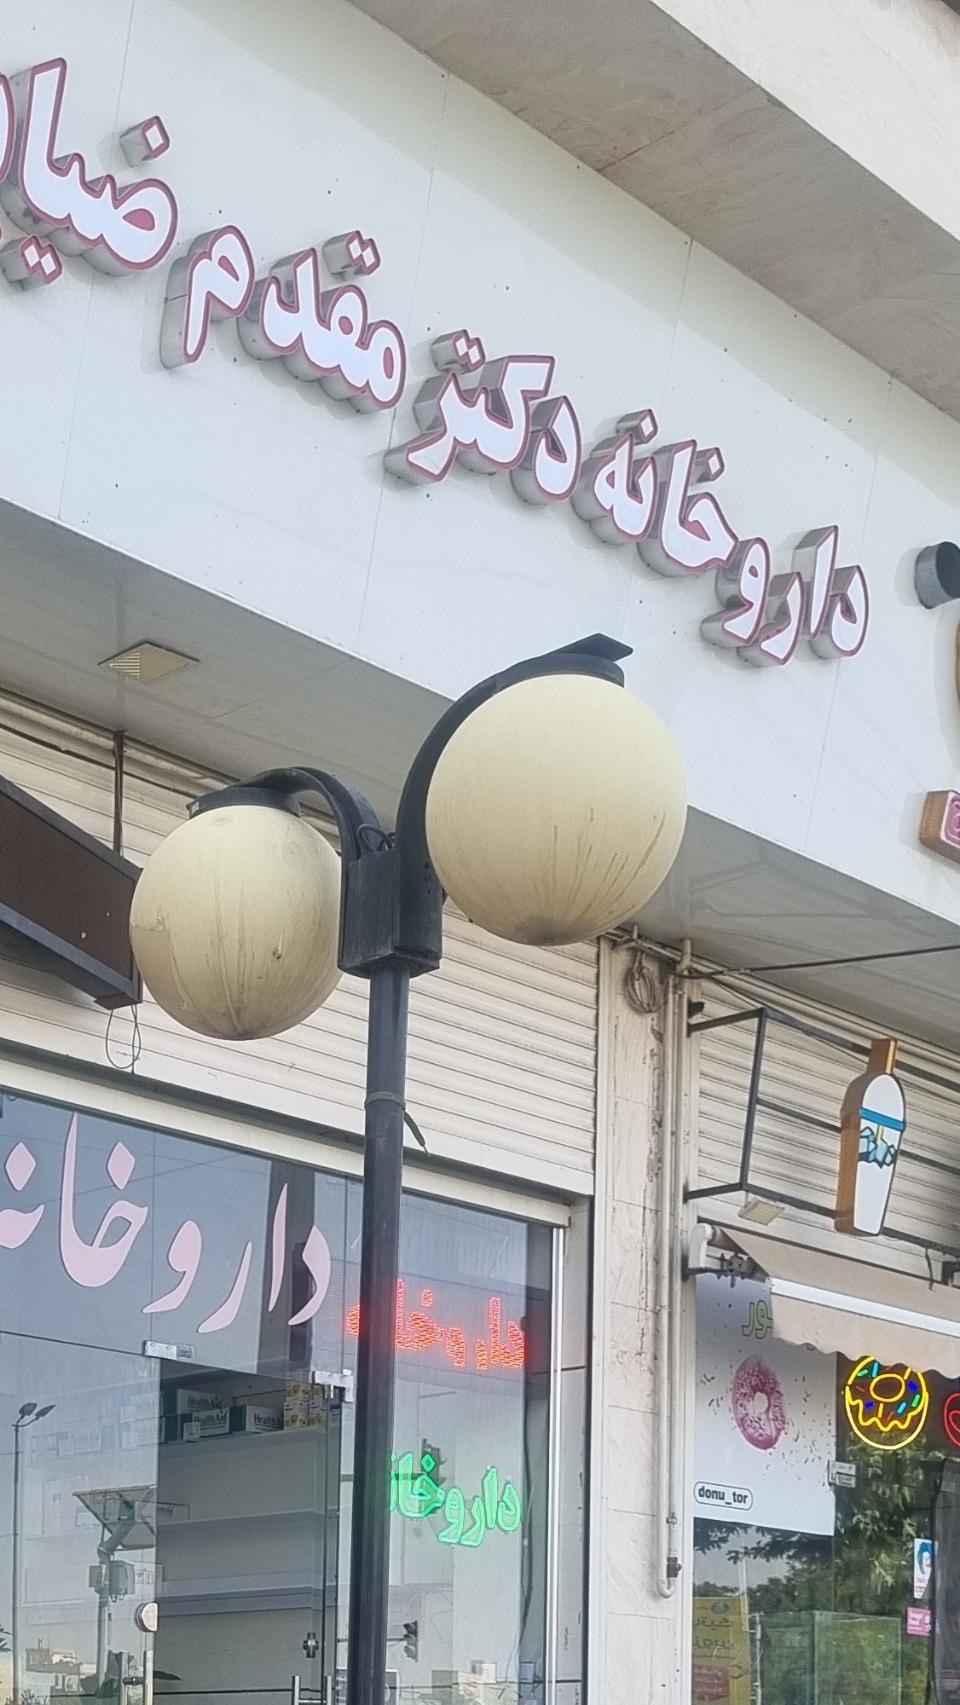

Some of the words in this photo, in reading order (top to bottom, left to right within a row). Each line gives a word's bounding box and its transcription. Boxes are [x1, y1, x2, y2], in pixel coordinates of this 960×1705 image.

[181, 225, 407, 409] مقدم
[407, 329, 581, 499] دکتر
[592, 408, 869, 666] داروخانه
[698, 1485, 748, 1505] donu_tor
